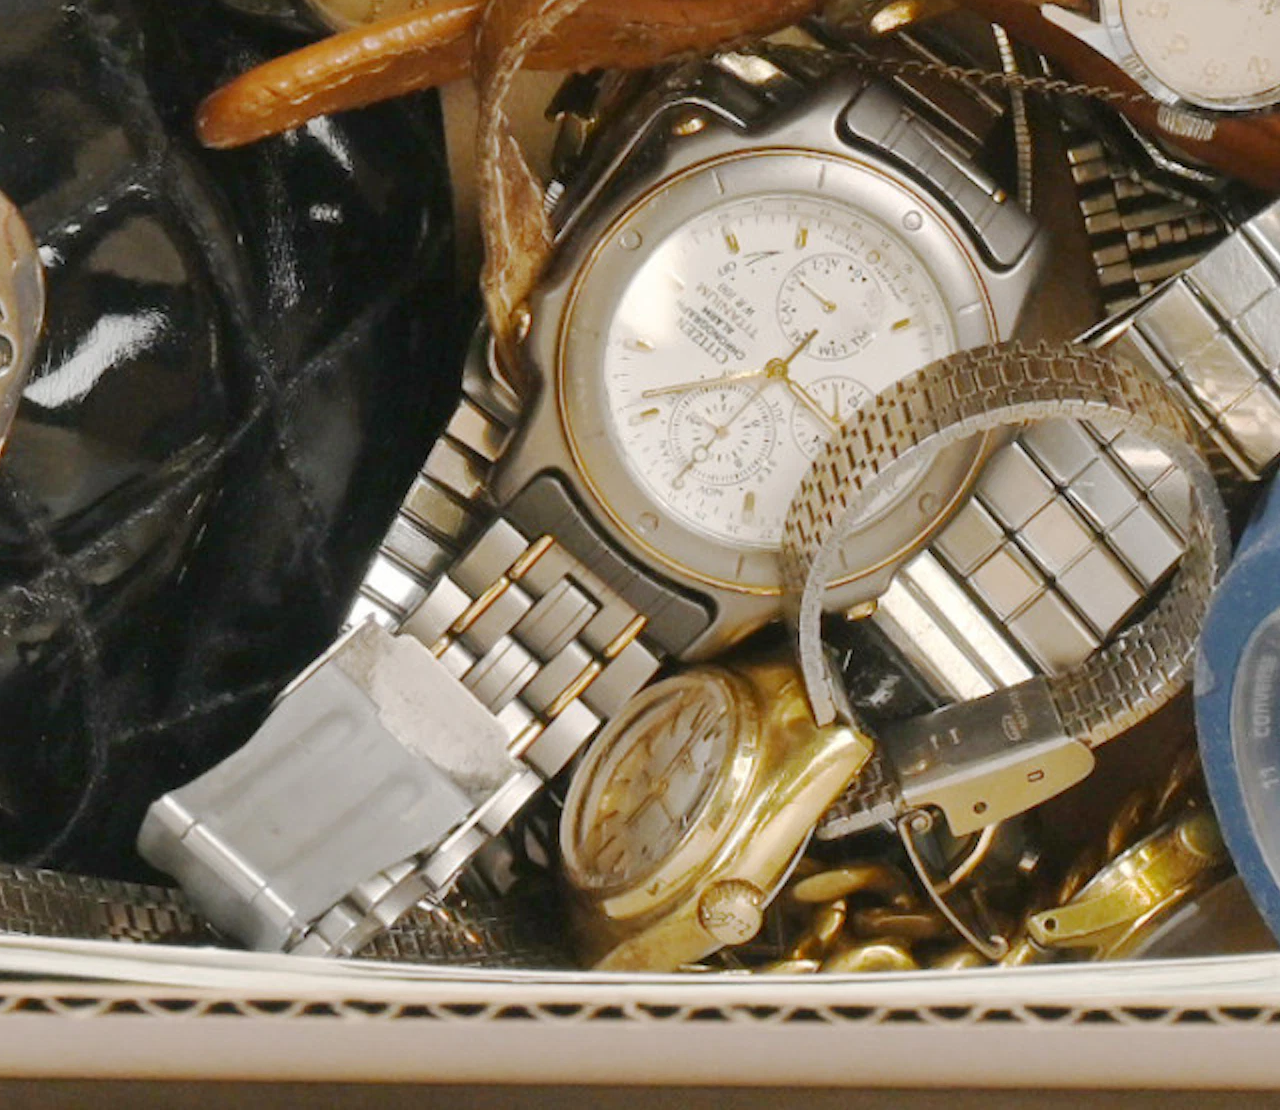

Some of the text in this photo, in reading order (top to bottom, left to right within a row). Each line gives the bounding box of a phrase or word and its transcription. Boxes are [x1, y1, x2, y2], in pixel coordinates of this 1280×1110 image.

[674, 295, 746, 362] CHRONOGRAPH
[694, 279, 761, 341] TITANIUM
[700, 304, 734, 336] ALARM
[673, 313, 730, 367] CITIZEN
